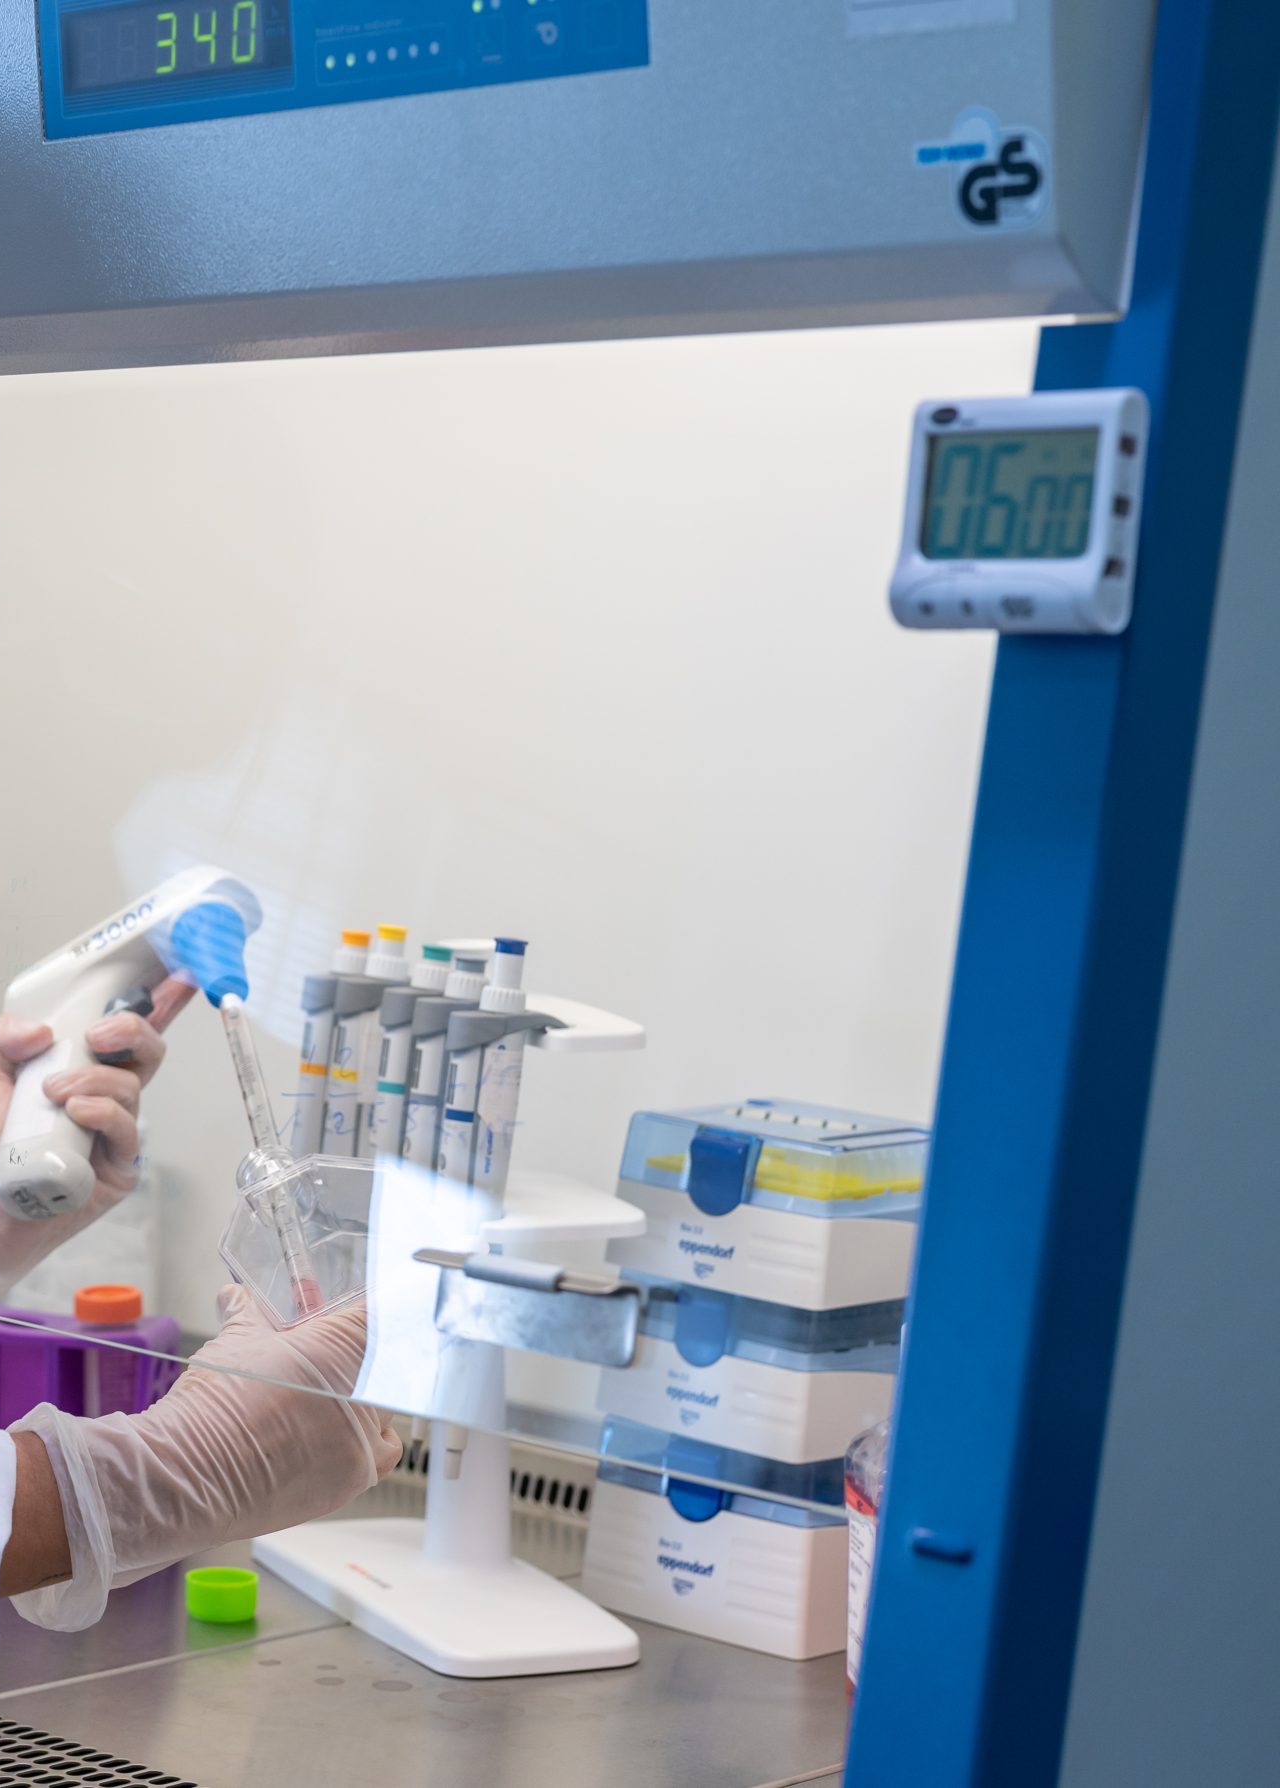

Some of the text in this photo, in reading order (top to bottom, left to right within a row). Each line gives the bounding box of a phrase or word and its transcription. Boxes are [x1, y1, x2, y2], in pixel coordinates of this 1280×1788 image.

[156, 1, 256, 74] 340
[958, 135, 1042, 225] GS
[678, 1238, 735, 1260] eppendorf
[656, 1553, 714, 1578] eppendorf
